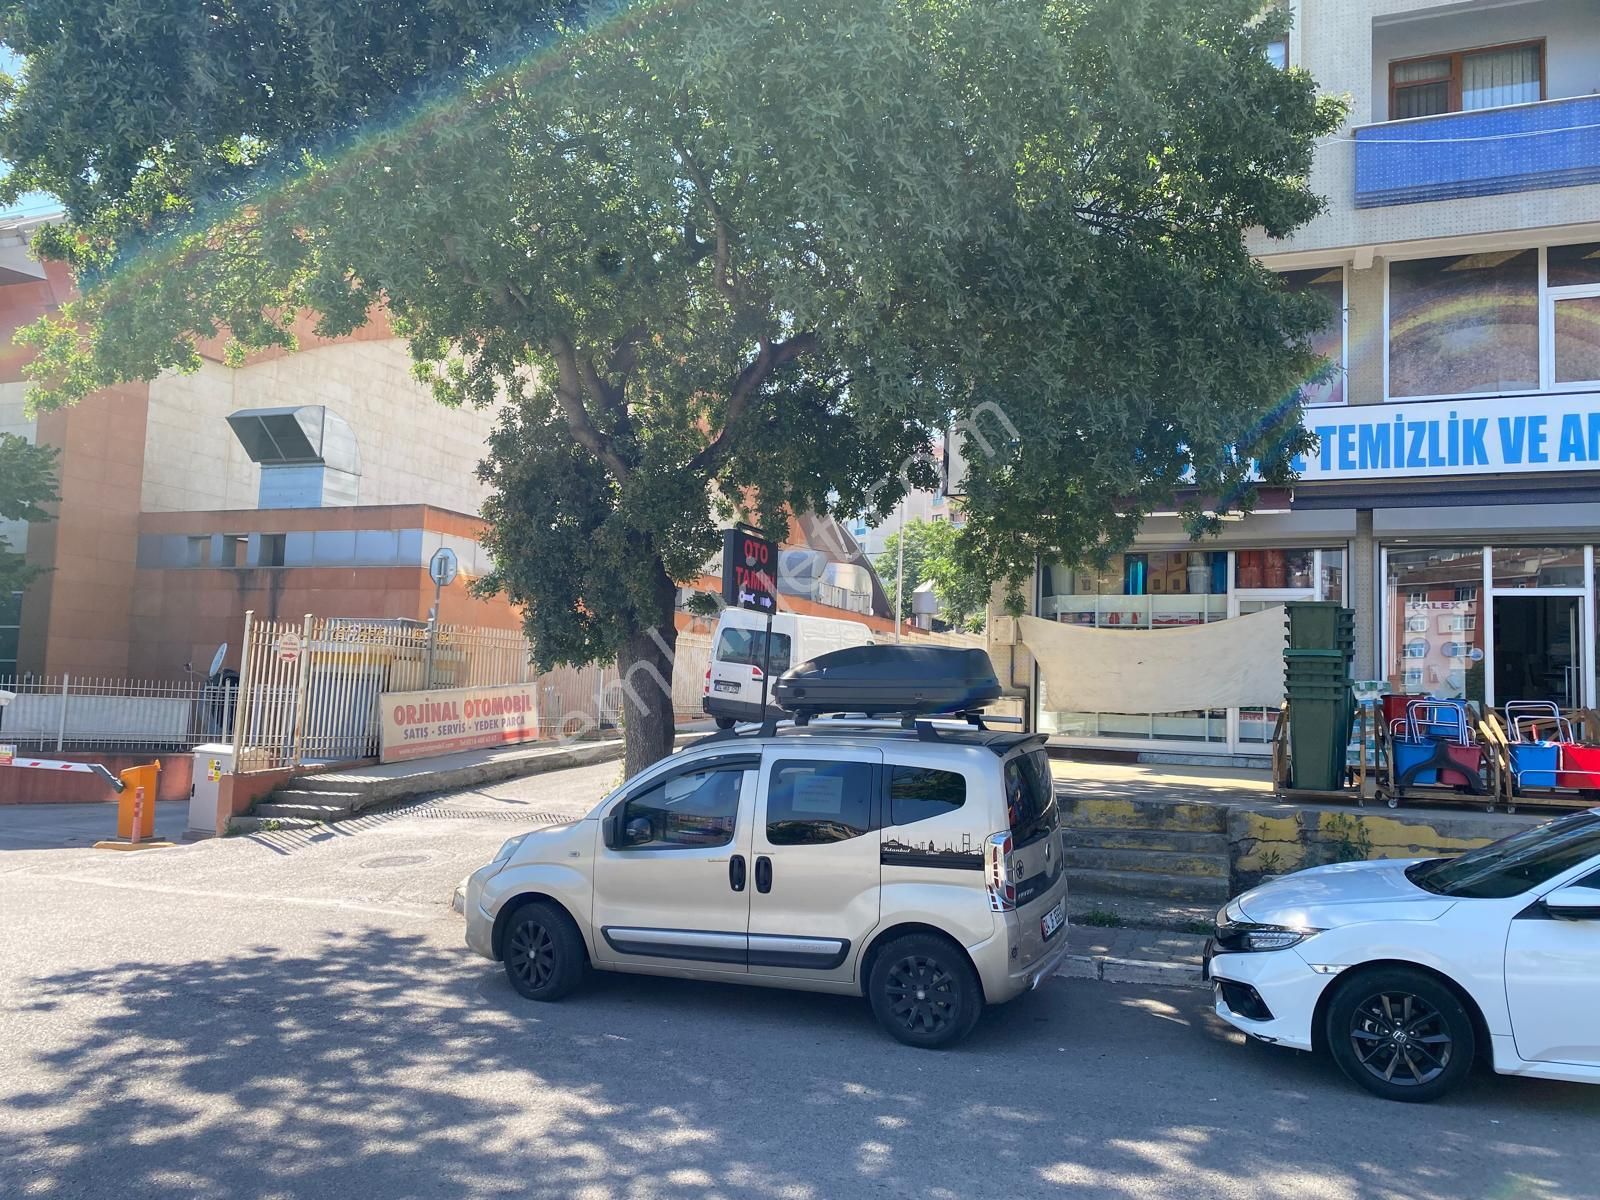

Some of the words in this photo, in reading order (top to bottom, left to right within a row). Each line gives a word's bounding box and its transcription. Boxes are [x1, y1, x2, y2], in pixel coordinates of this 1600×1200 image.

[1318, 410, 1489, 471] TEMİZLİK
[1498, 415, 1548, 465] VE
[744, 540, 769, 564] OTO
[1411, 602, 1461, 610] PALEX
[393, 697, 460, 727] ORJİNAL
[463, 689, 533, 719] OTOMOBİL
[437, 720, 466, 737] SERVİS
[474, 718, 499, 731] YEDEK
